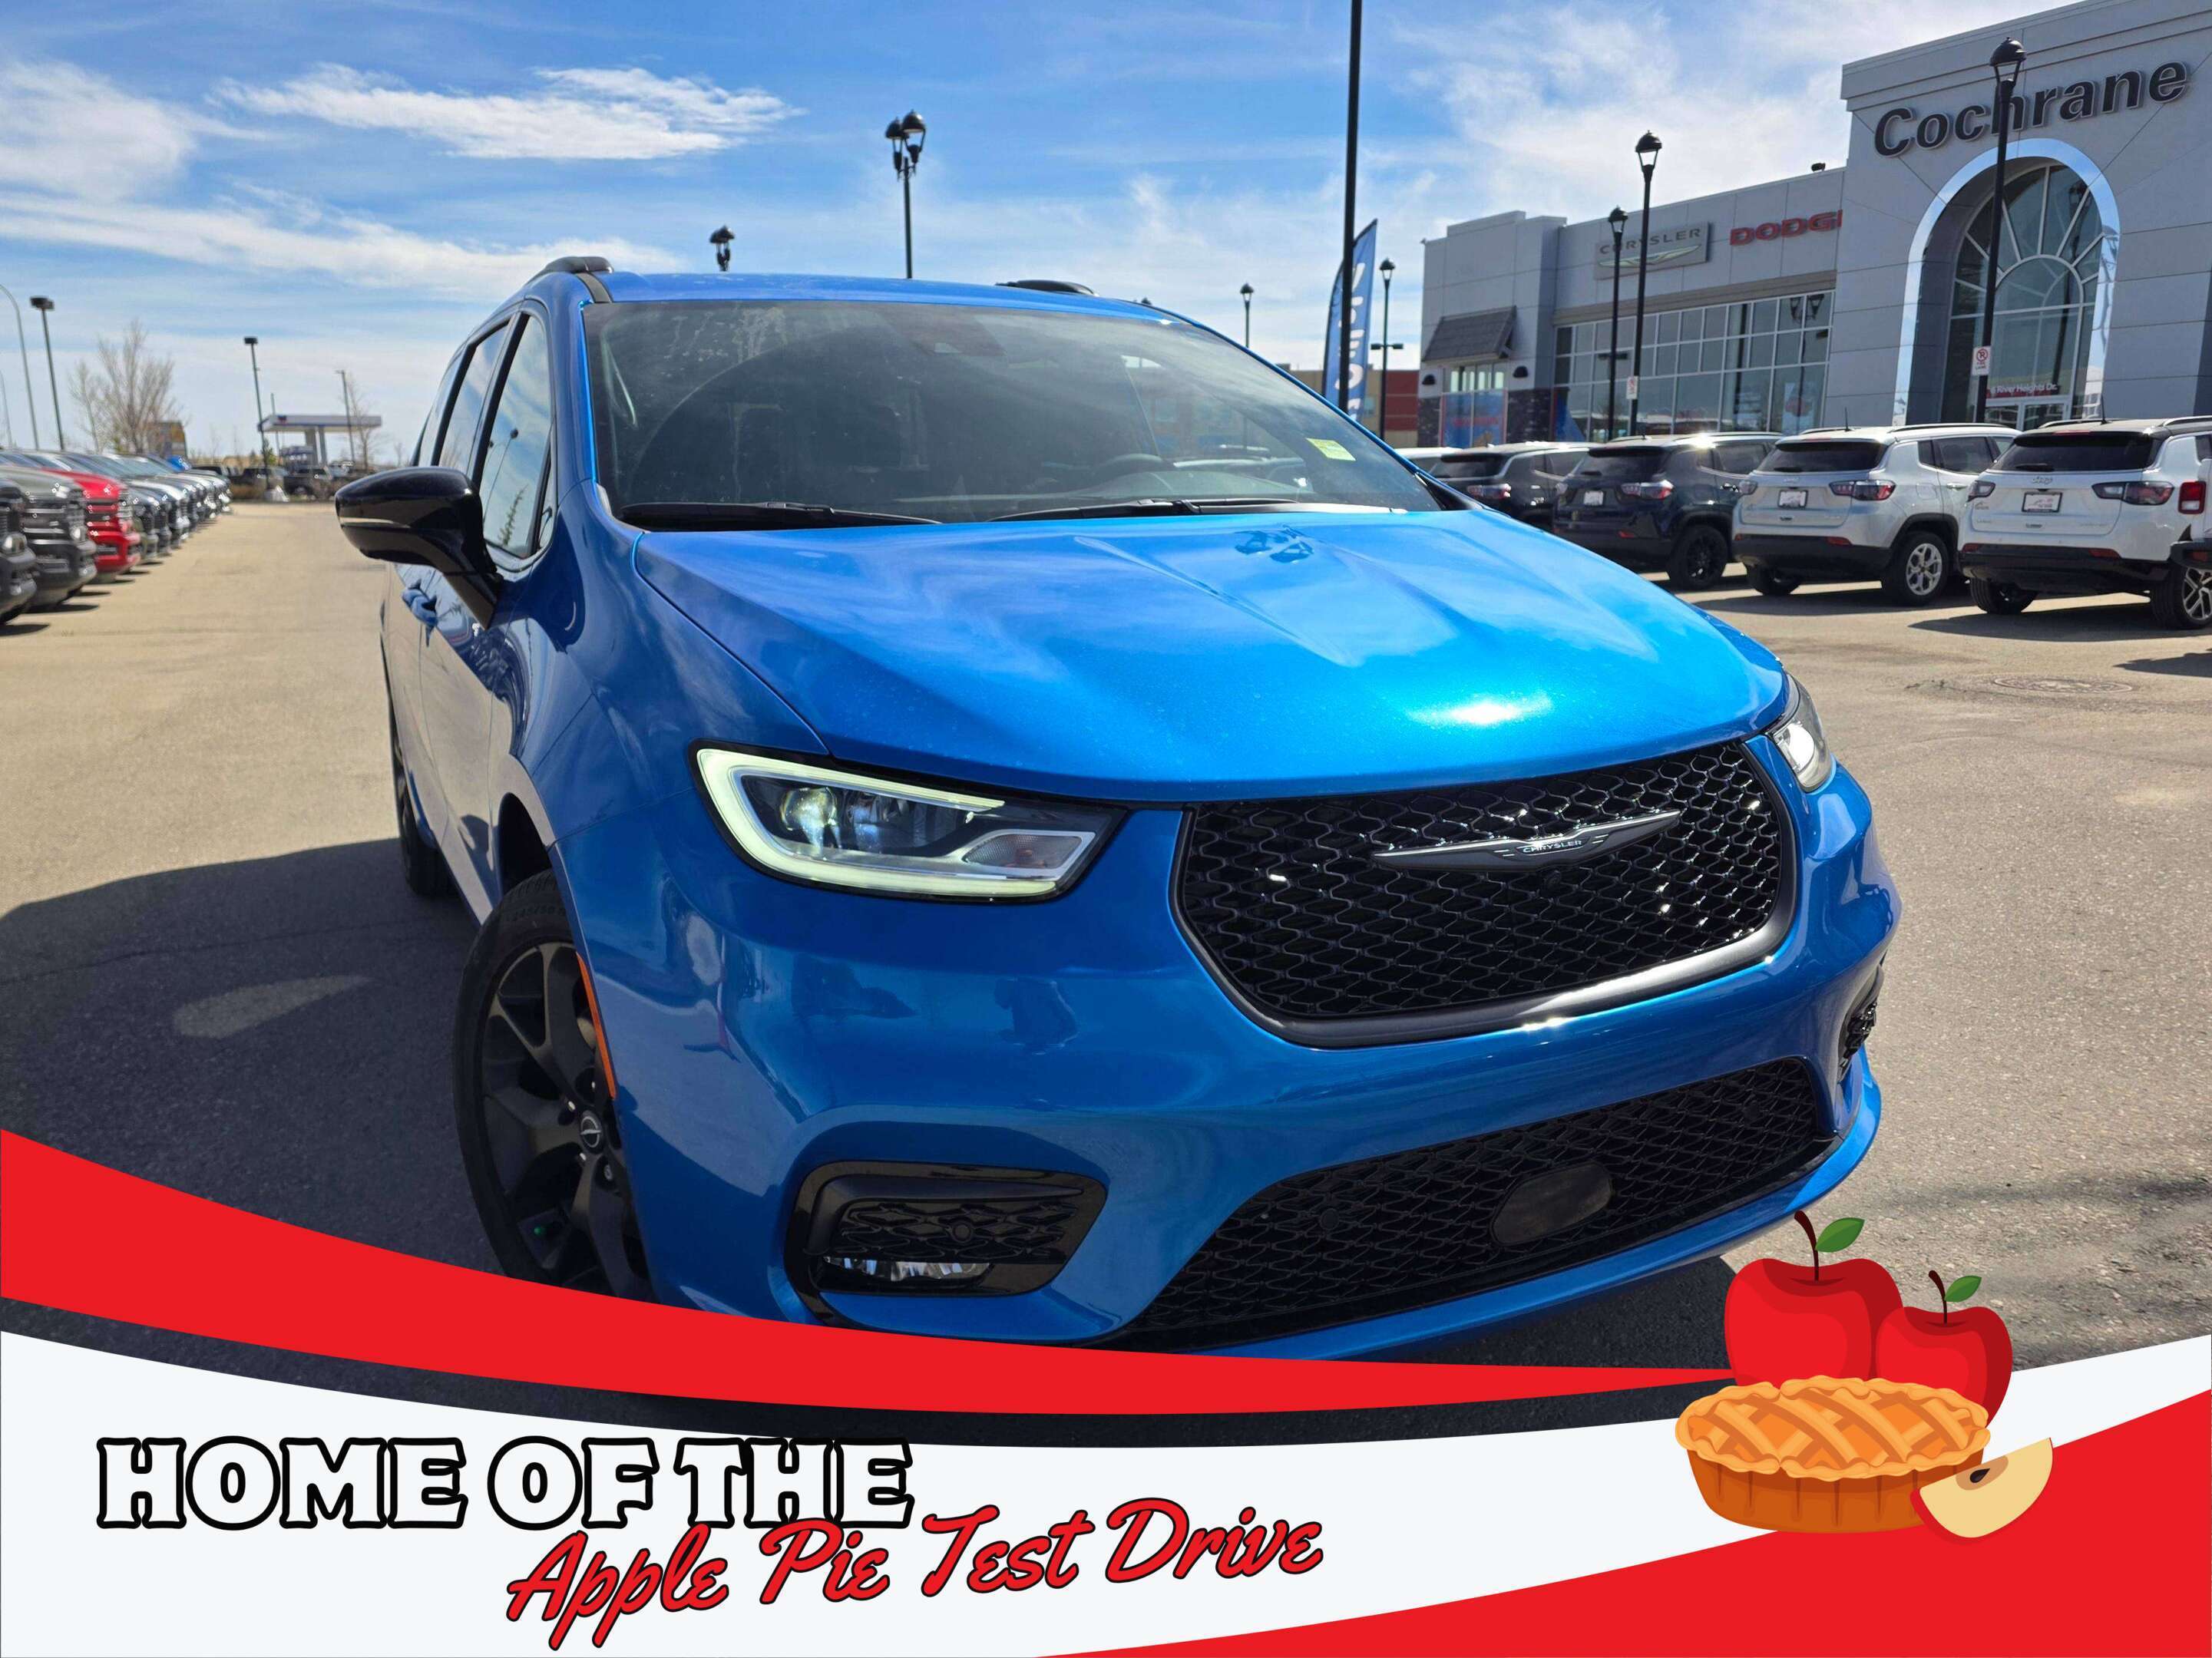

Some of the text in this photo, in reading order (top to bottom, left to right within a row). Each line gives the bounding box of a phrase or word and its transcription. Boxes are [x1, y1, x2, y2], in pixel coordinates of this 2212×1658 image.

[1874, 61, 2188, 157] Cochrane
[1599, 228, 1701, 254] CRSLER
[1523, 840, 1582, 853] CHRYSLER
